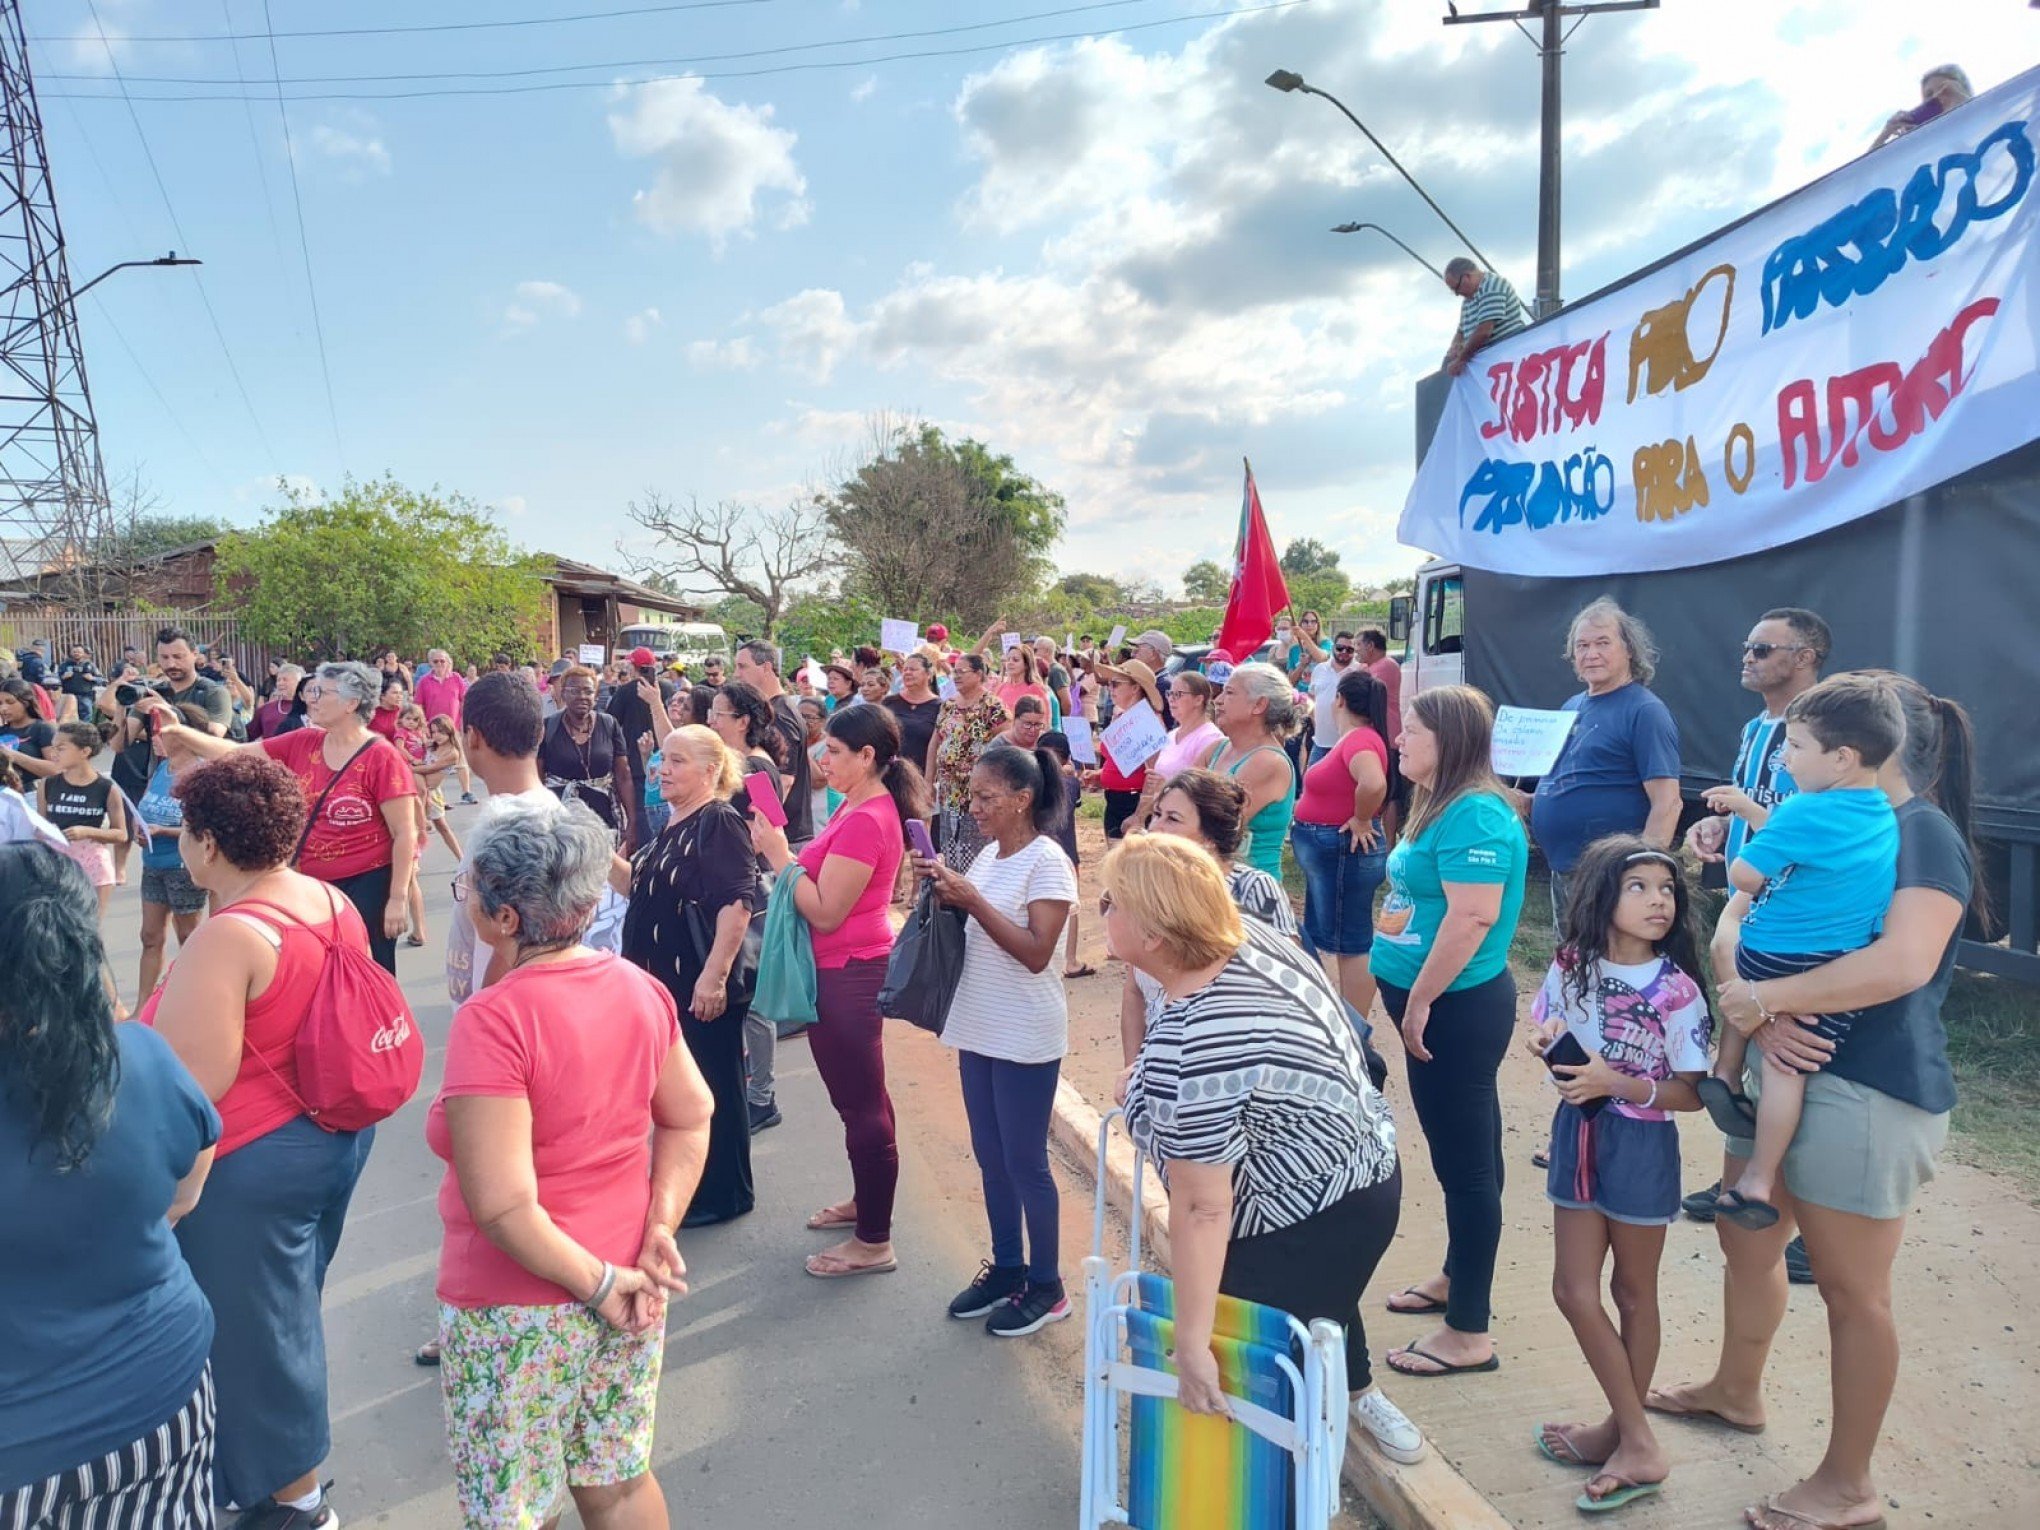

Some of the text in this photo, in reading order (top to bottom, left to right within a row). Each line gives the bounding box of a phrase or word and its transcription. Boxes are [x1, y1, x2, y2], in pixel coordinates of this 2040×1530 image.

[1632, 434, 1711, 523] PARA
[1724, 422, 1755, 496] O
[1619, 1017, 1666, 1060] TIME
